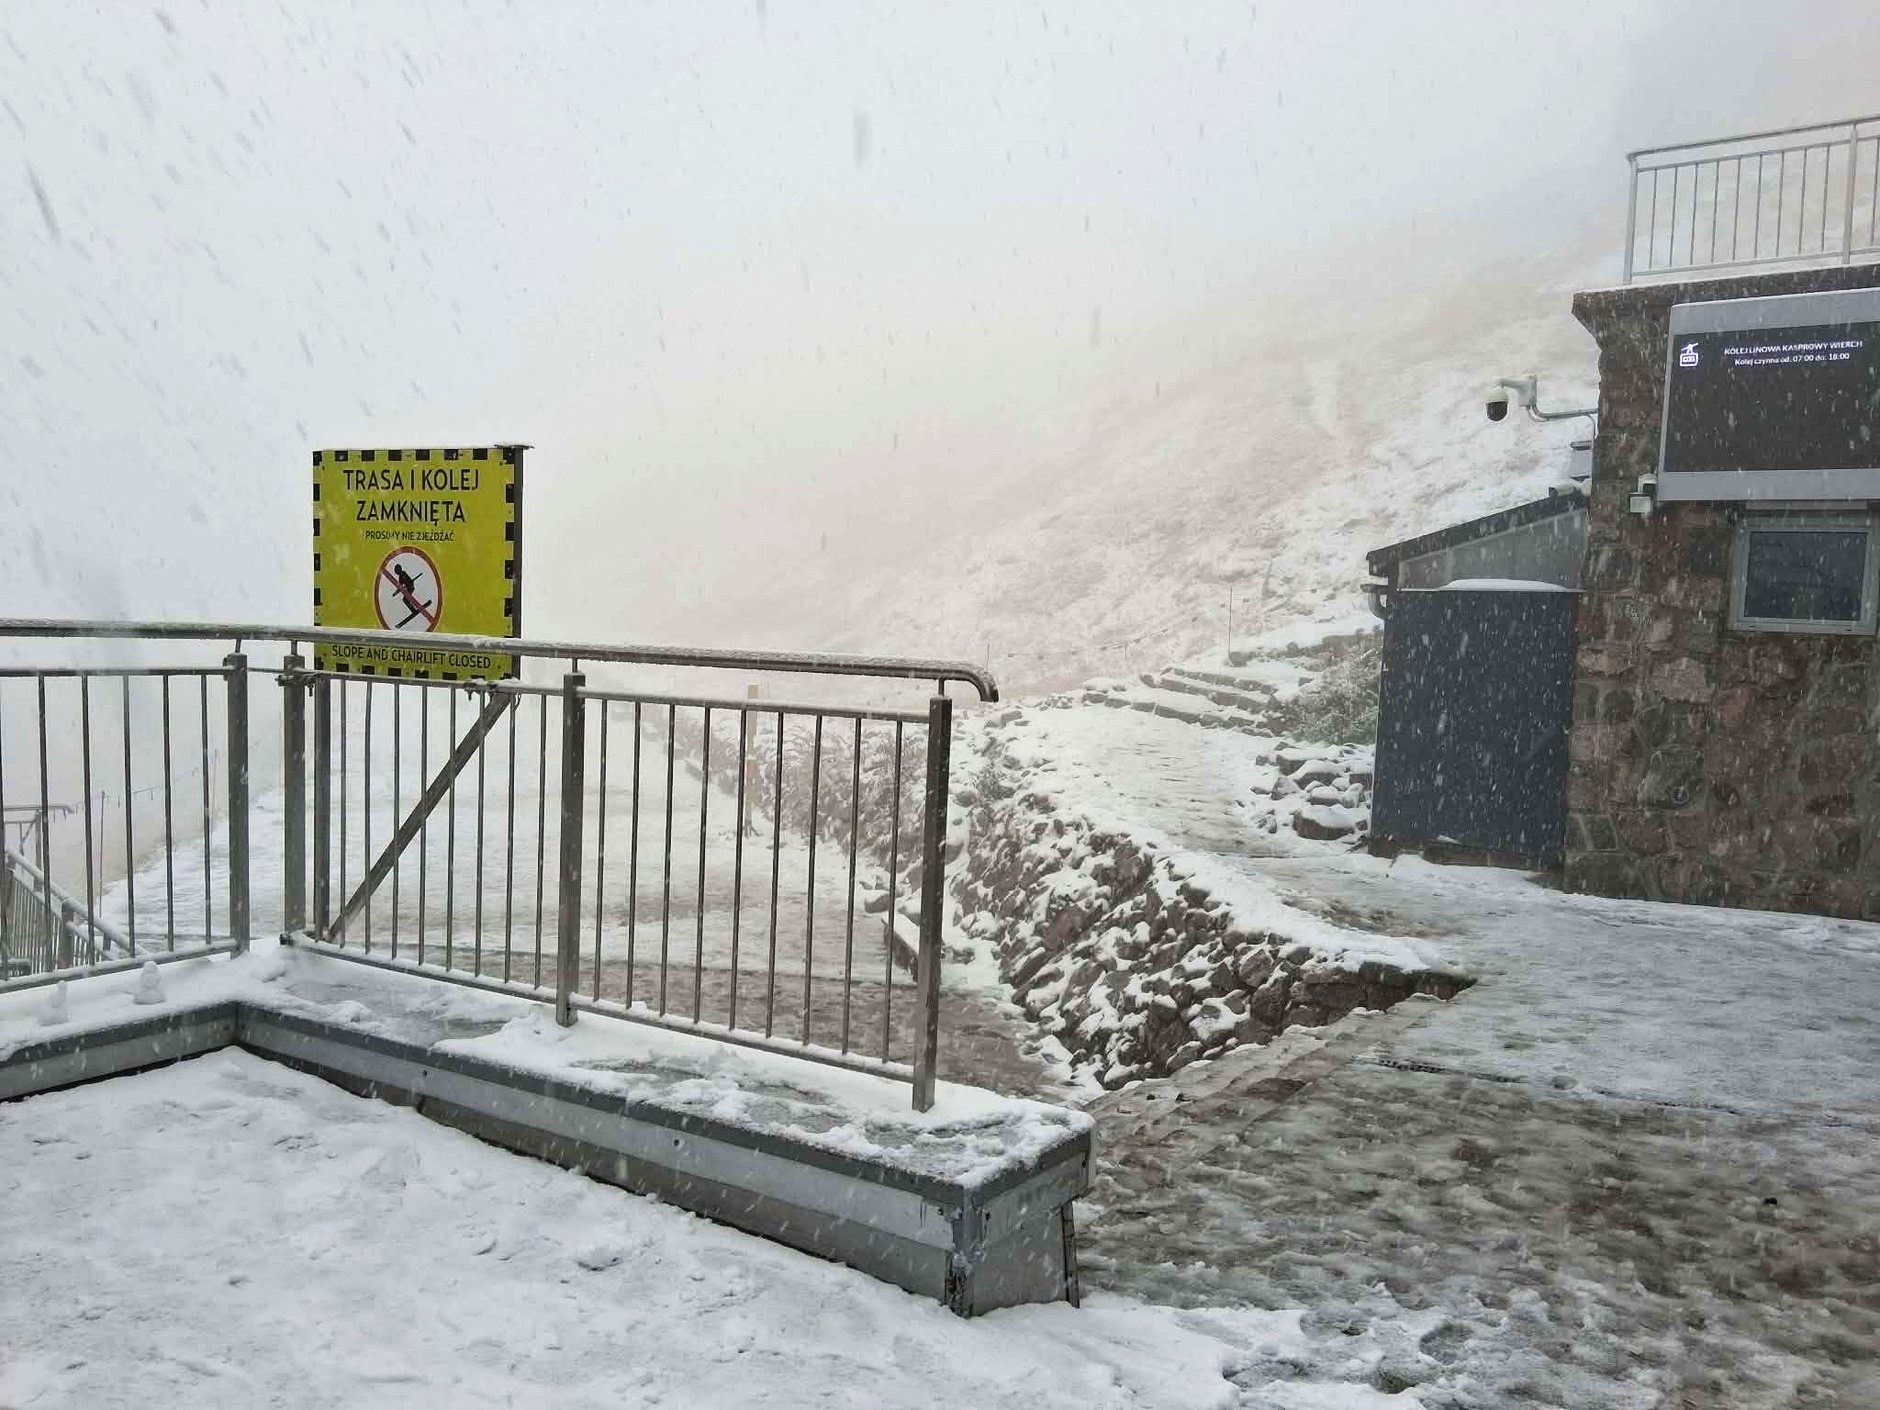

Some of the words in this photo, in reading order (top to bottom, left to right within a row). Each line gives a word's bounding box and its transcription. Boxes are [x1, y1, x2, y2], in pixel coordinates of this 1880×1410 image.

[343, 469, 404, 491] TRASA
[411, 469, 415, 491] I
[422, 468, 479, 491] KOLEJ
[356, 500, 465, 526] ZAMKNIĘTA
[402, 531, 415, 541] NIE
[332, 645, 363, 658] SLOPE
[367, 648, 388, 661] AND
[391, 649, 446, 666] CHAIRLIFT
[449, 654, 491, 669] CLOSED
